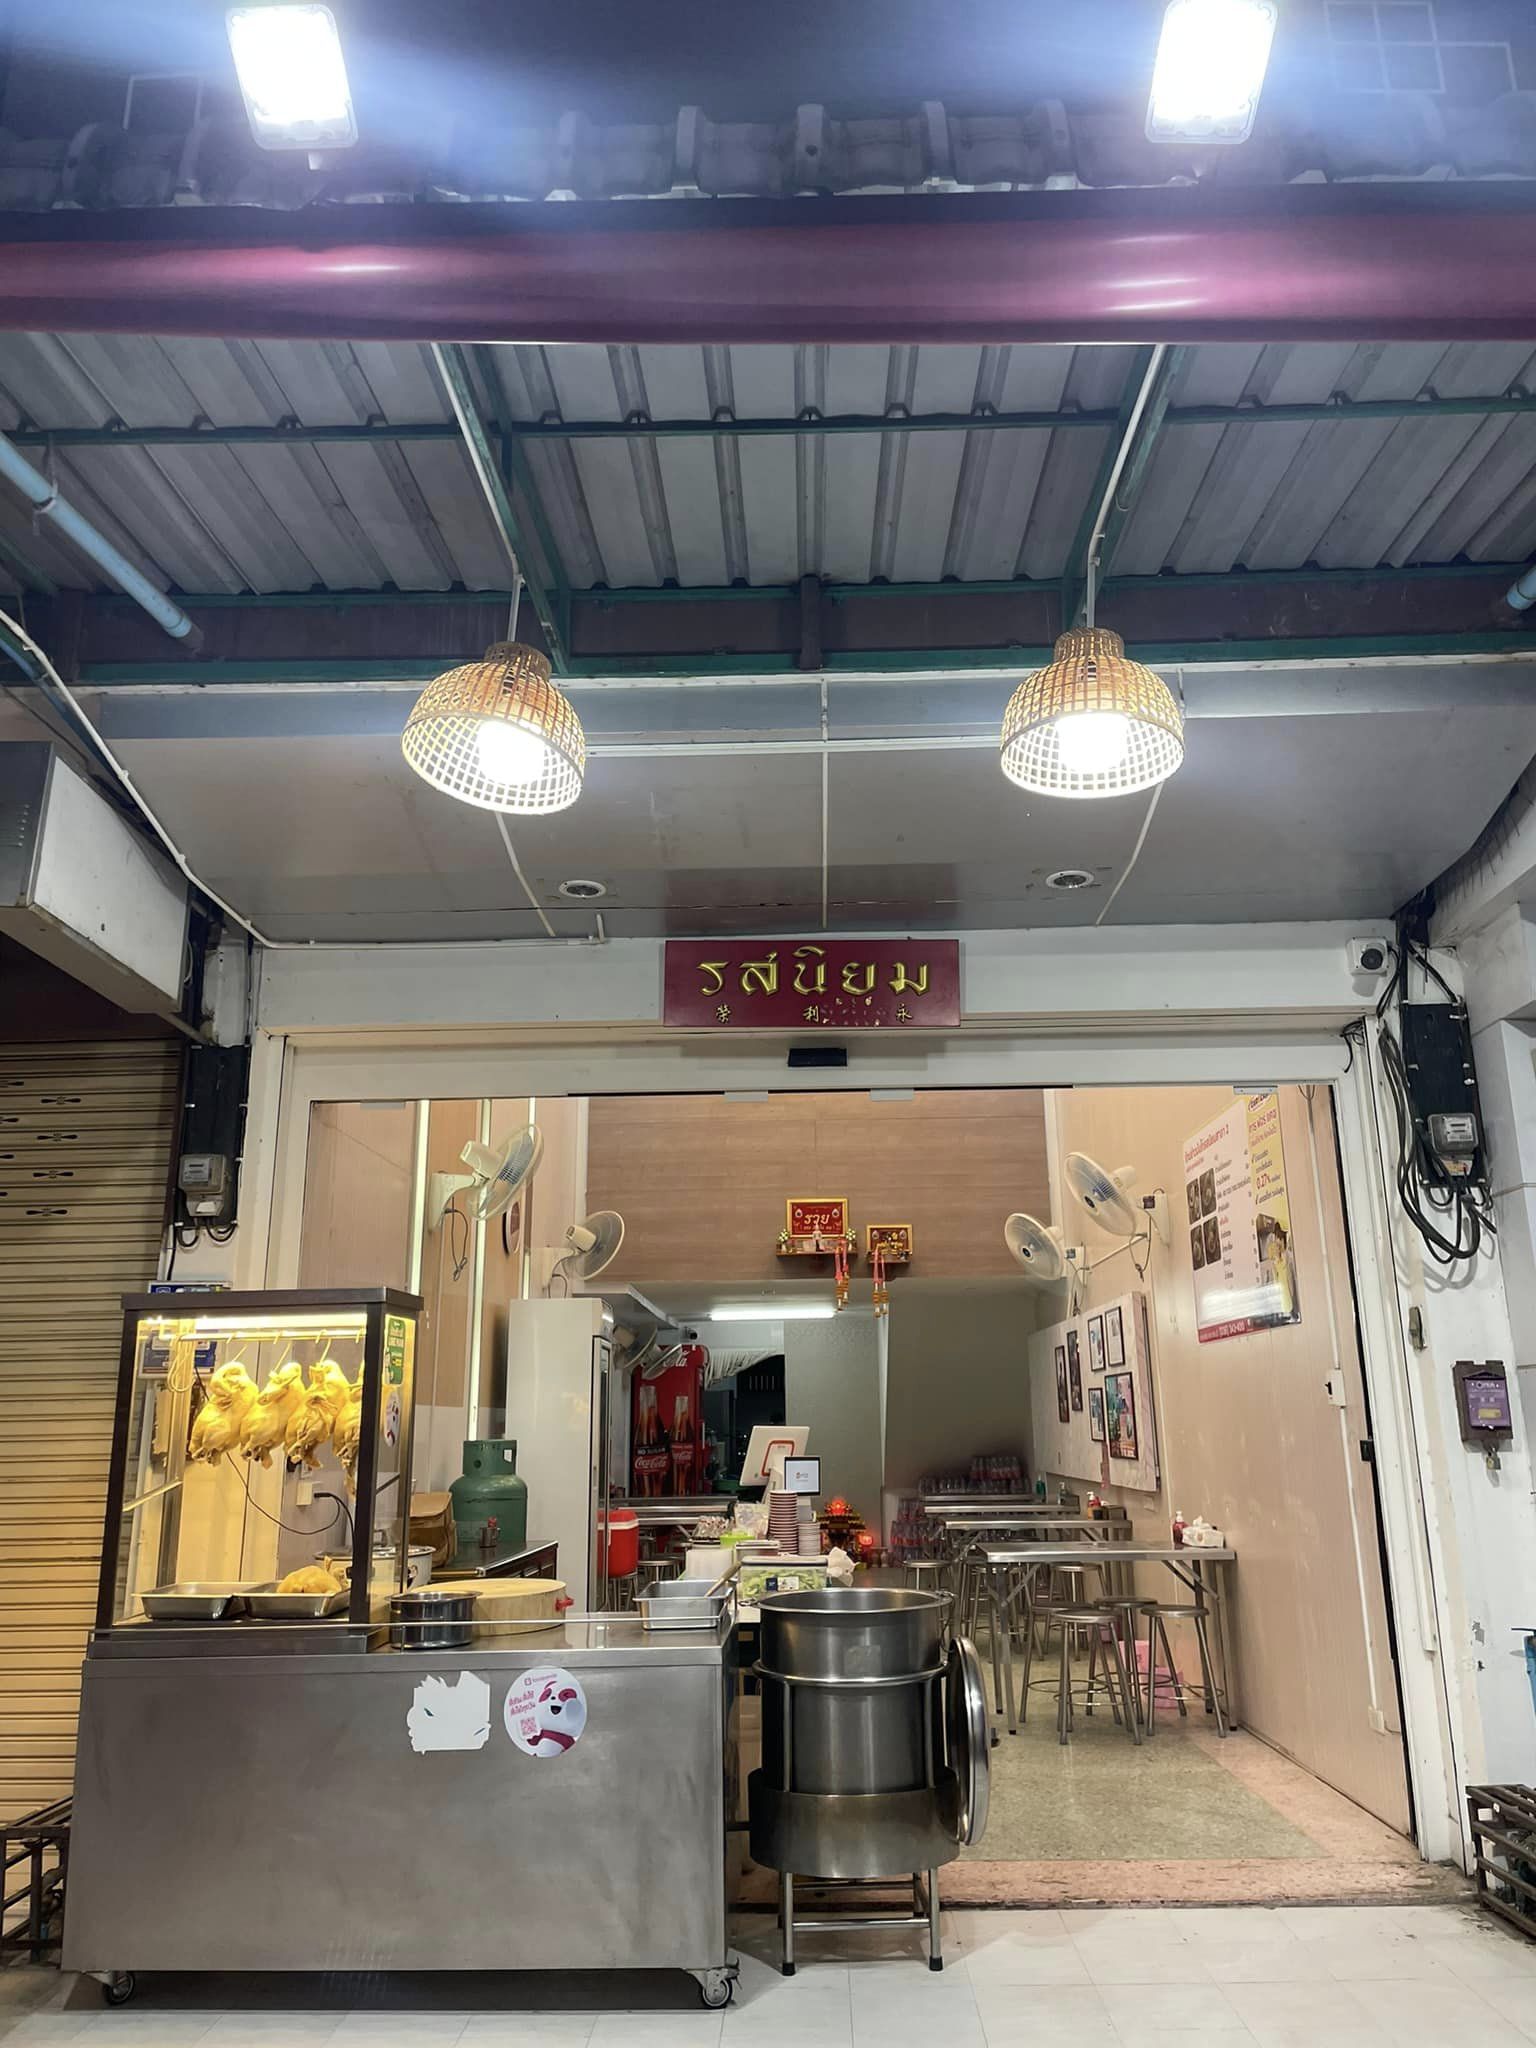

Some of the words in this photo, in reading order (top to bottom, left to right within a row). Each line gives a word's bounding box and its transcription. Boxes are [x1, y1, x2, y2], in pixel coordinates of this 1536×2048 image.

[696, 945, 929, 996] รสนิยม
[634, 1455, 668, 1469] Coca-Cola
